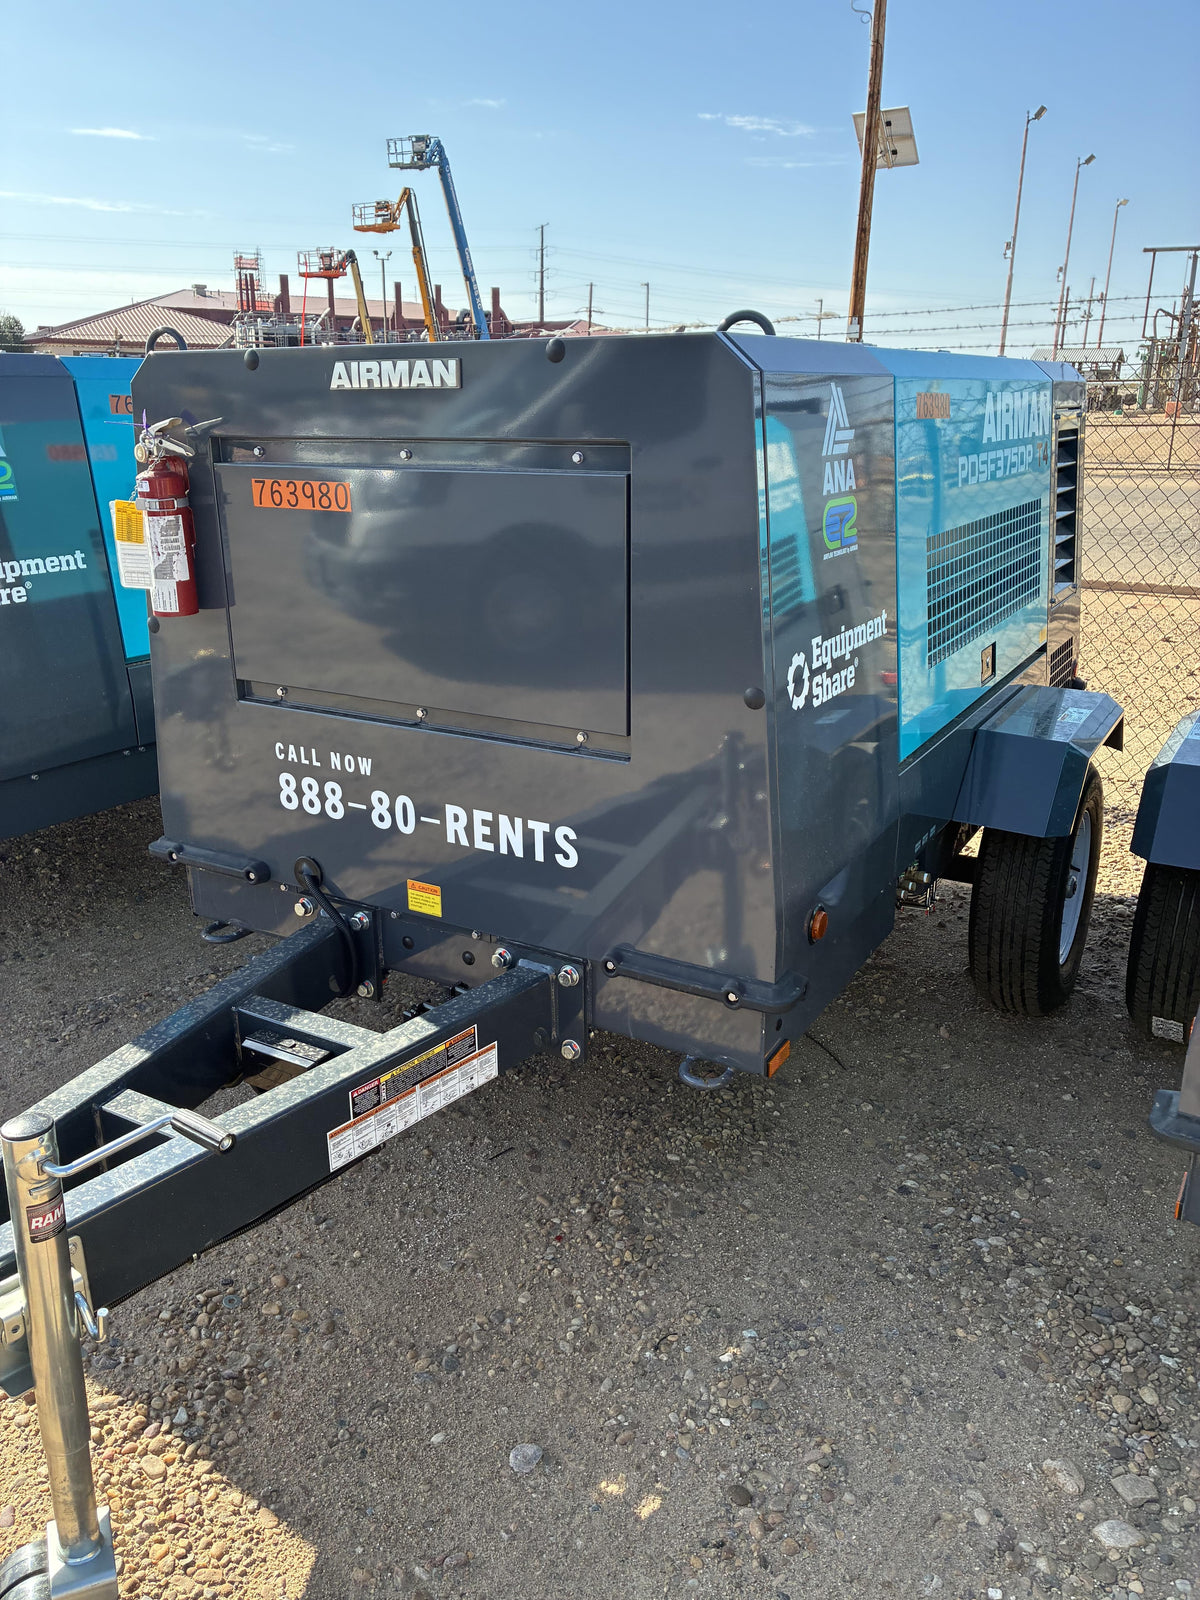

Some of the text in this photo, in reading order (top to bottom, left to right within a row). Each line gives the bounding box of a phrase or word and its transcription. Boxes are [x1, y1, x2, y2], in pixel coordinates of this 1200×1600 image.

[330, 359, 458, 389] AIRMAN
[917, 392, 950, 419] 763980
[982, 391, 1050, 444] AIRMAN
[822, 458, 857, 496] ANA
[958, 441, 1049, 488] PDSF375DP T4
[254, 480, 348, 510] 763980
[811, 608, 888, 670] Equipment
[275, 742, 372, 776] CALL NOW
[278, 772, 579, 869] 888-80-RENTS
[357, 1079, 379, 1095] DANGER
[31, 1203, 64, 1230] RAM
